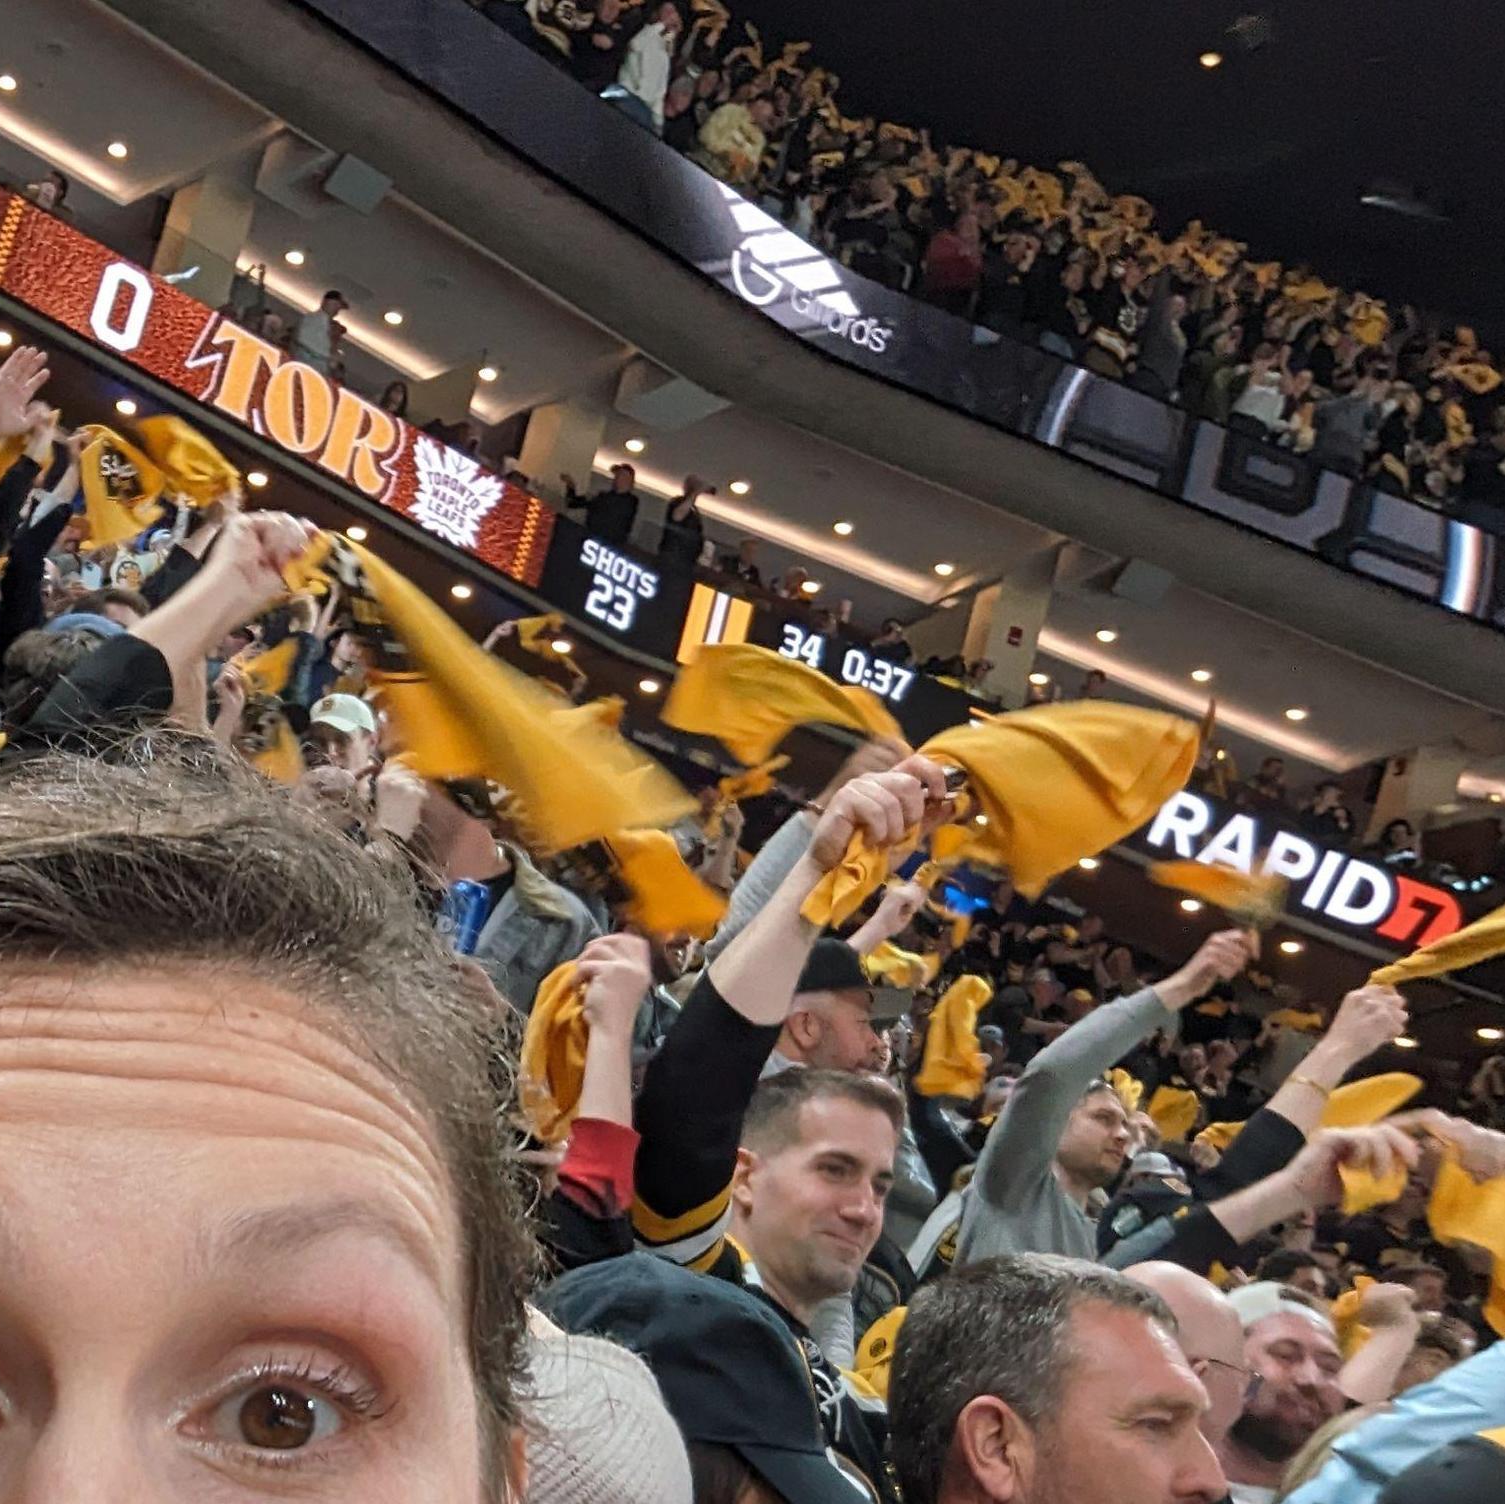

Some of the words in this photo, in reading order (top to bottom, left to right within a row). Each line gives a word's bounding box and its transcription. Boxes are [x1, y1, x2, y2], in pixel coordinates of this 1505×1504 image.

[90, 261, 153, 352] 0
[211, 317, 396, 497] TOR
[426, 470, 481, 510] TORONTO
[427, 500, 466, 528] LEAFS
[432, 486, 469, 516] MAPLE
[580, 538, 659, 599] SHOTS
[583, 574, 638, 632] 23
[777, 622, 827, 670] 34
[840, 649, 915, 702] 0:37
